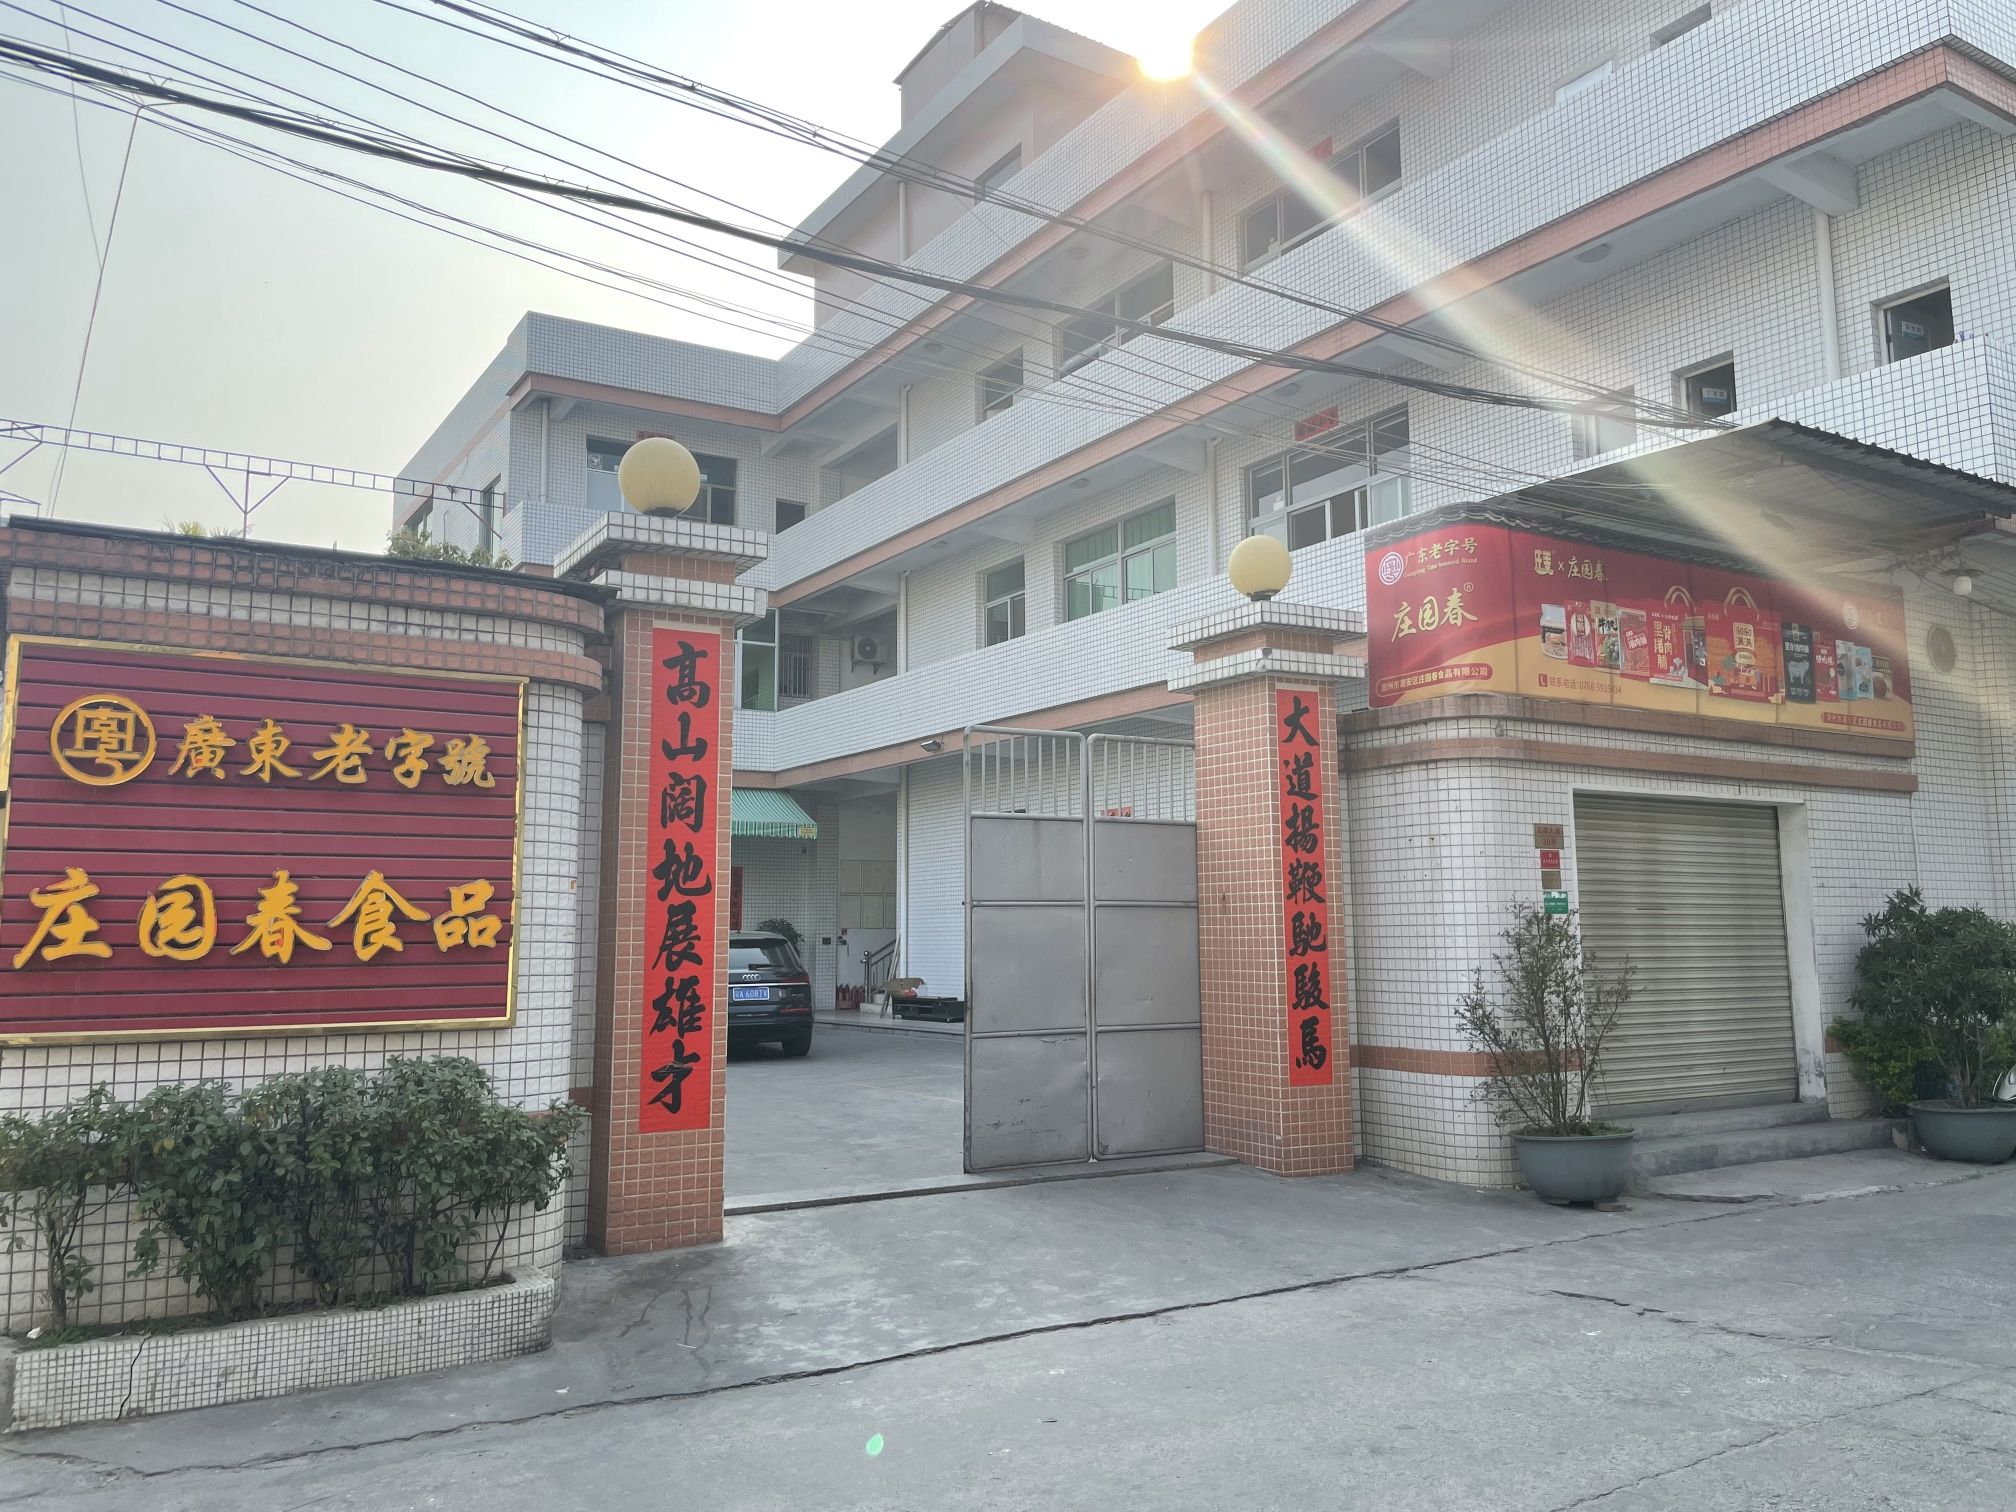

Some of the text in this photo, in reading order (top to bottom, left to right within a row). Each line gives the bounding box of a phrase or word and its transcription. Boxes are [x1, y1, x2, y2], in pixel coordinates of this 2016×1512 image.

[1404, 537, 1478, 569] 广东老字号
[1567, 556, 1608, 584] 庄园春
[1391, 587, 1478, 643] 庄园春
[168, 713, 497, 790] 廣東老字號
[13, 867, 503, 971] 庄园春食品
